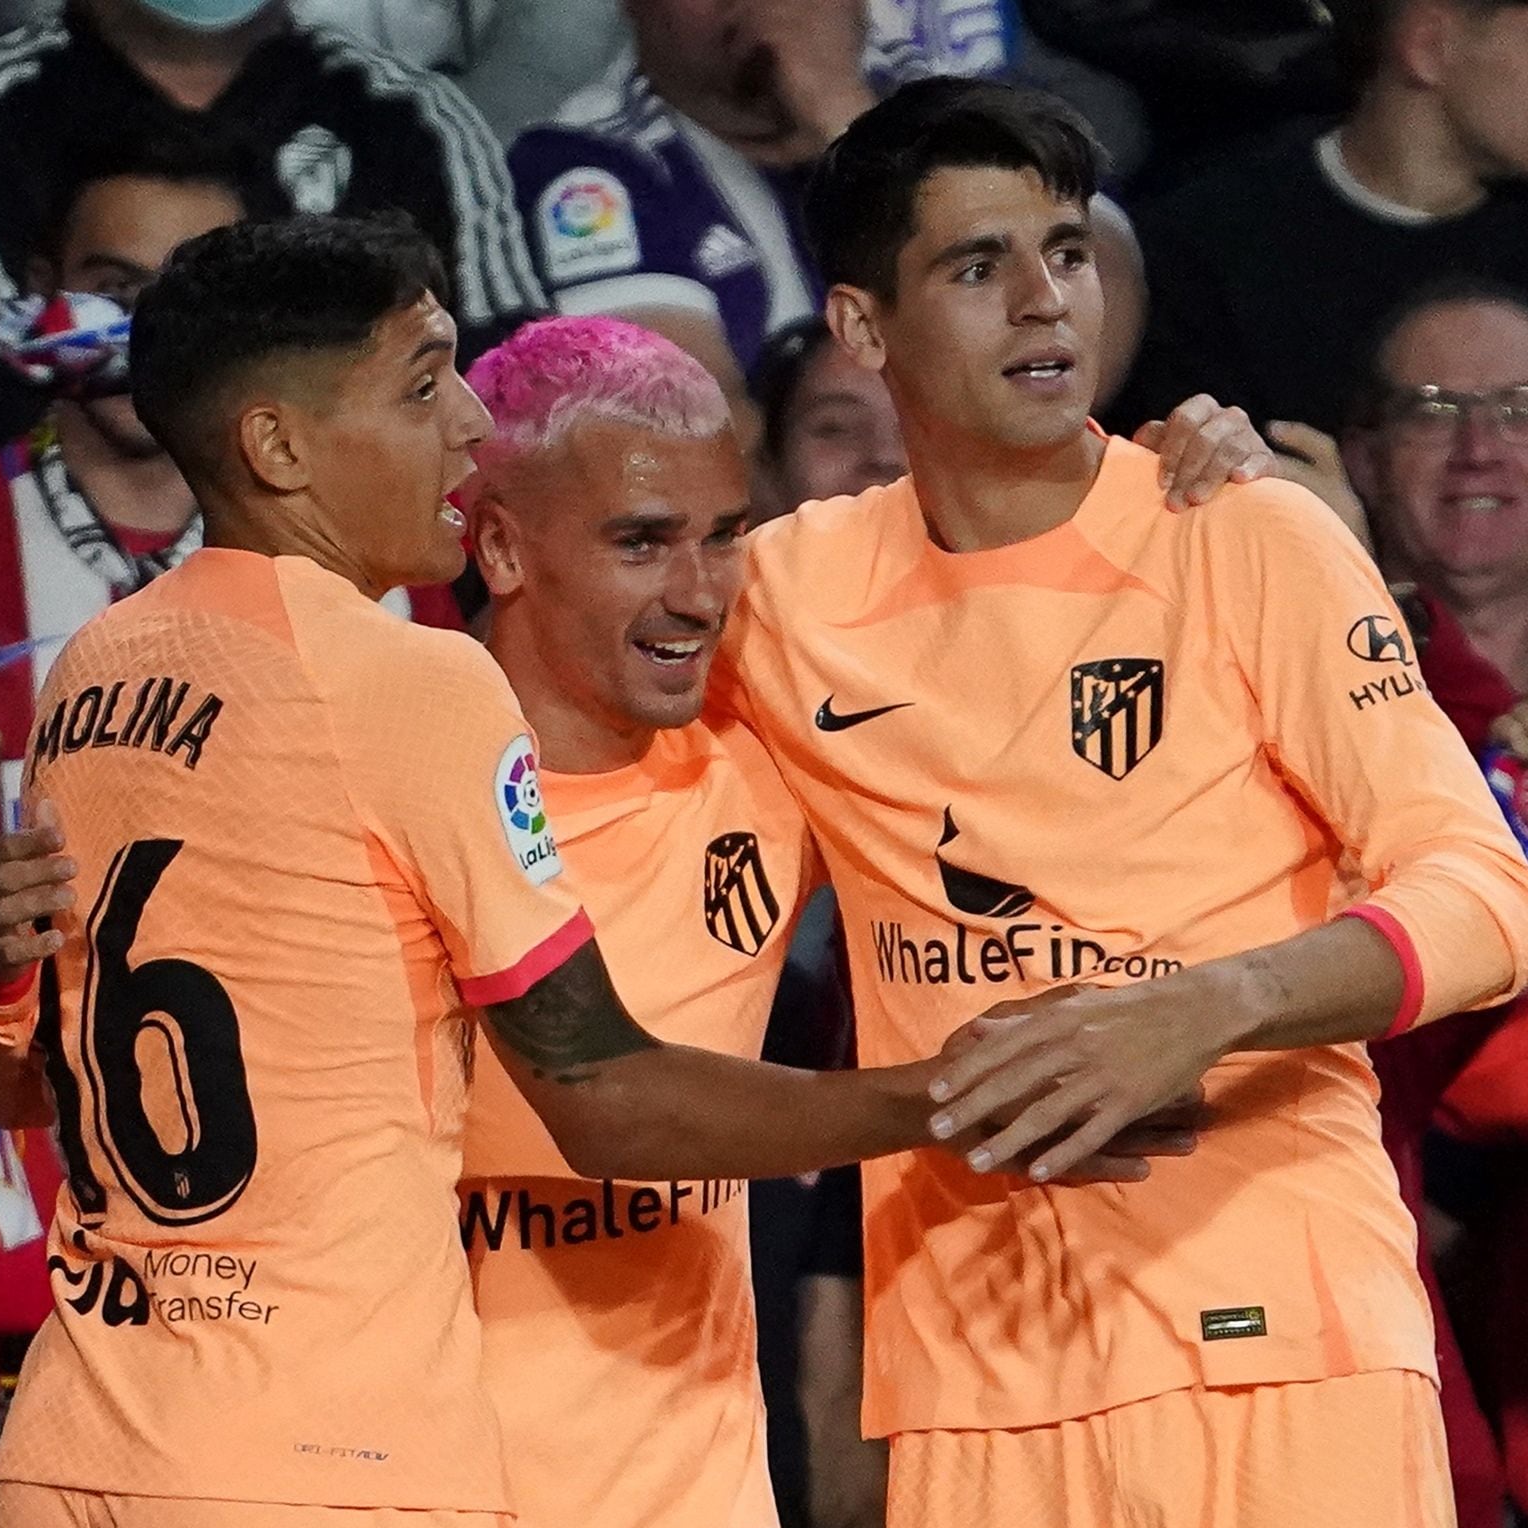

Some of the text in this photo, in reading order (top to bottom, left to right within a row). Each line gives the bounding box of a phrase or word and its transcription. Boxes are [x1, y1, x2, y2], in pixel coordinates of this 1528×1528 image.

[29, 677, 223, 770] MOLINA
[34, 838, 258, 1230] 16
[144, 1249, 257, 1290] Money
